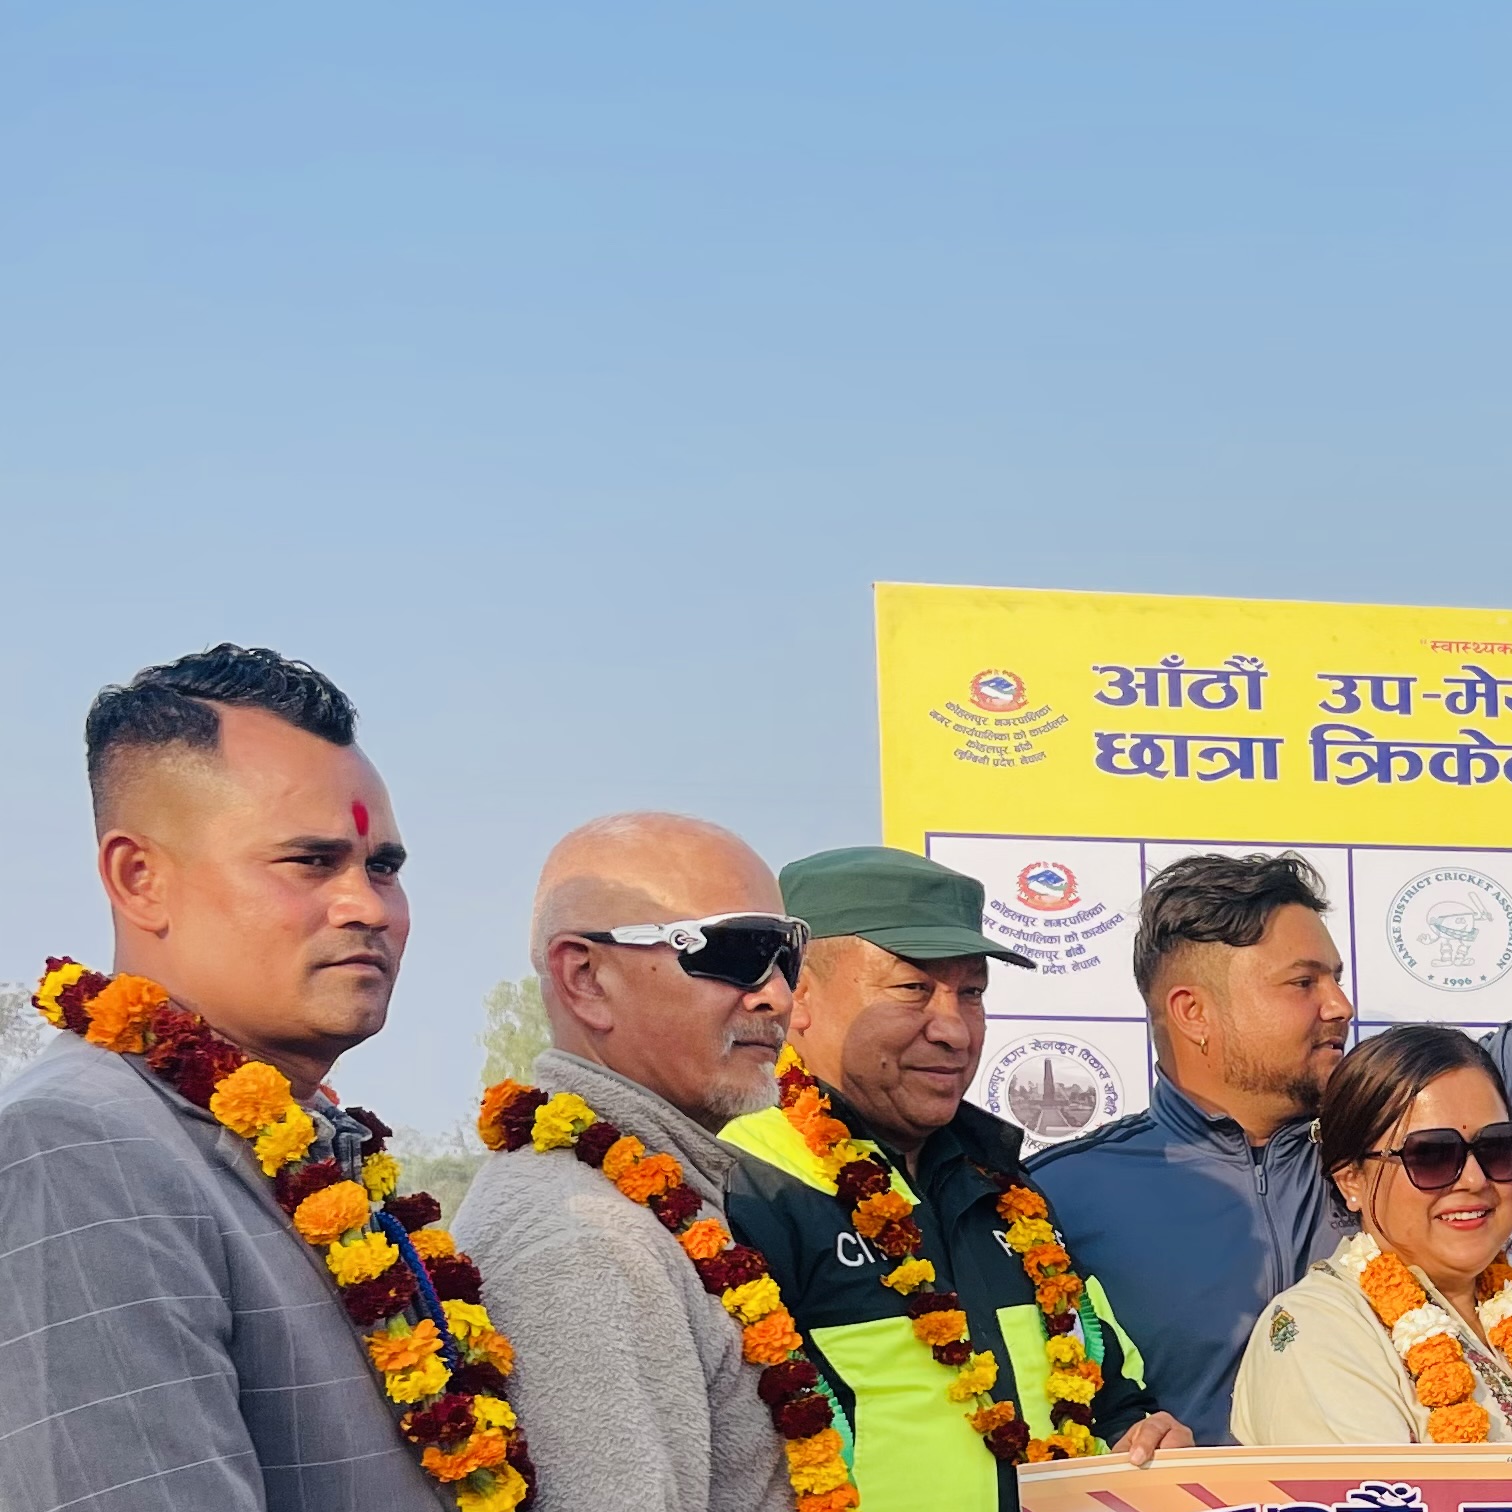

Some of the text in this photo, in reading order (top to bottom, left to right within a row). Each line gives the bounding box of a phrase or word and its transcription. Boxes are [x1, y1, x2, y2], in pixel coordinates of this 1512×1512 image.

[1094, 732, 1285, 782] छात्रा
[1392, 876, 1433, 924] DISTRICT
[1434, 872, 1494, 892] CRICKET
[1442, 977, 1474, 987] 1996
